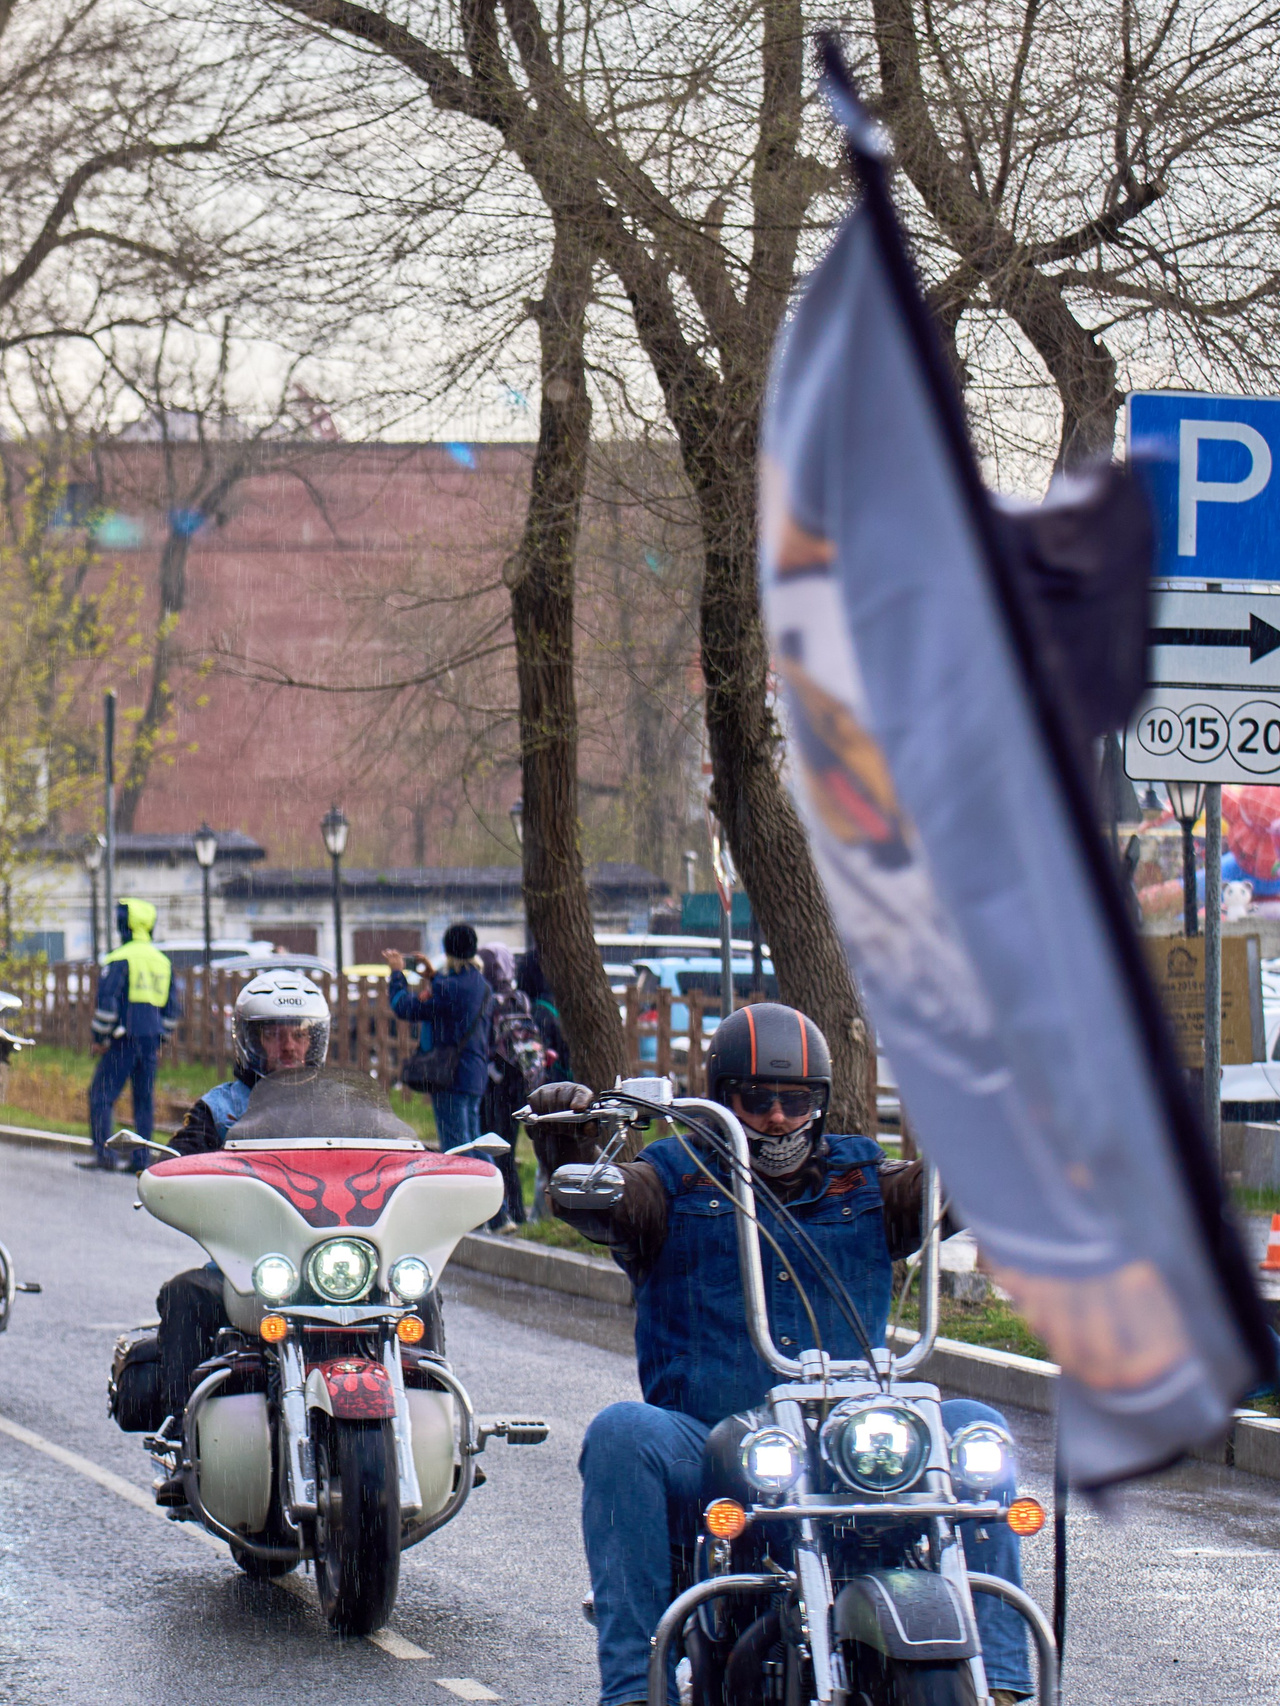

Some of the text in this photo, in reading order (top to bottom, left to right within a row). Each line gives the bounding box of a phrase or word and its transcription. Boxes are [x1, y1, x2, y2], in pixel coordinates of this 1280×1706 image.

[1178, 419, 1272, 557] P
[1147, 719, 1173, 743] 10
[1185, 717, 1220, 750] 15
[278, 997, 302, 1006] SHOEI
